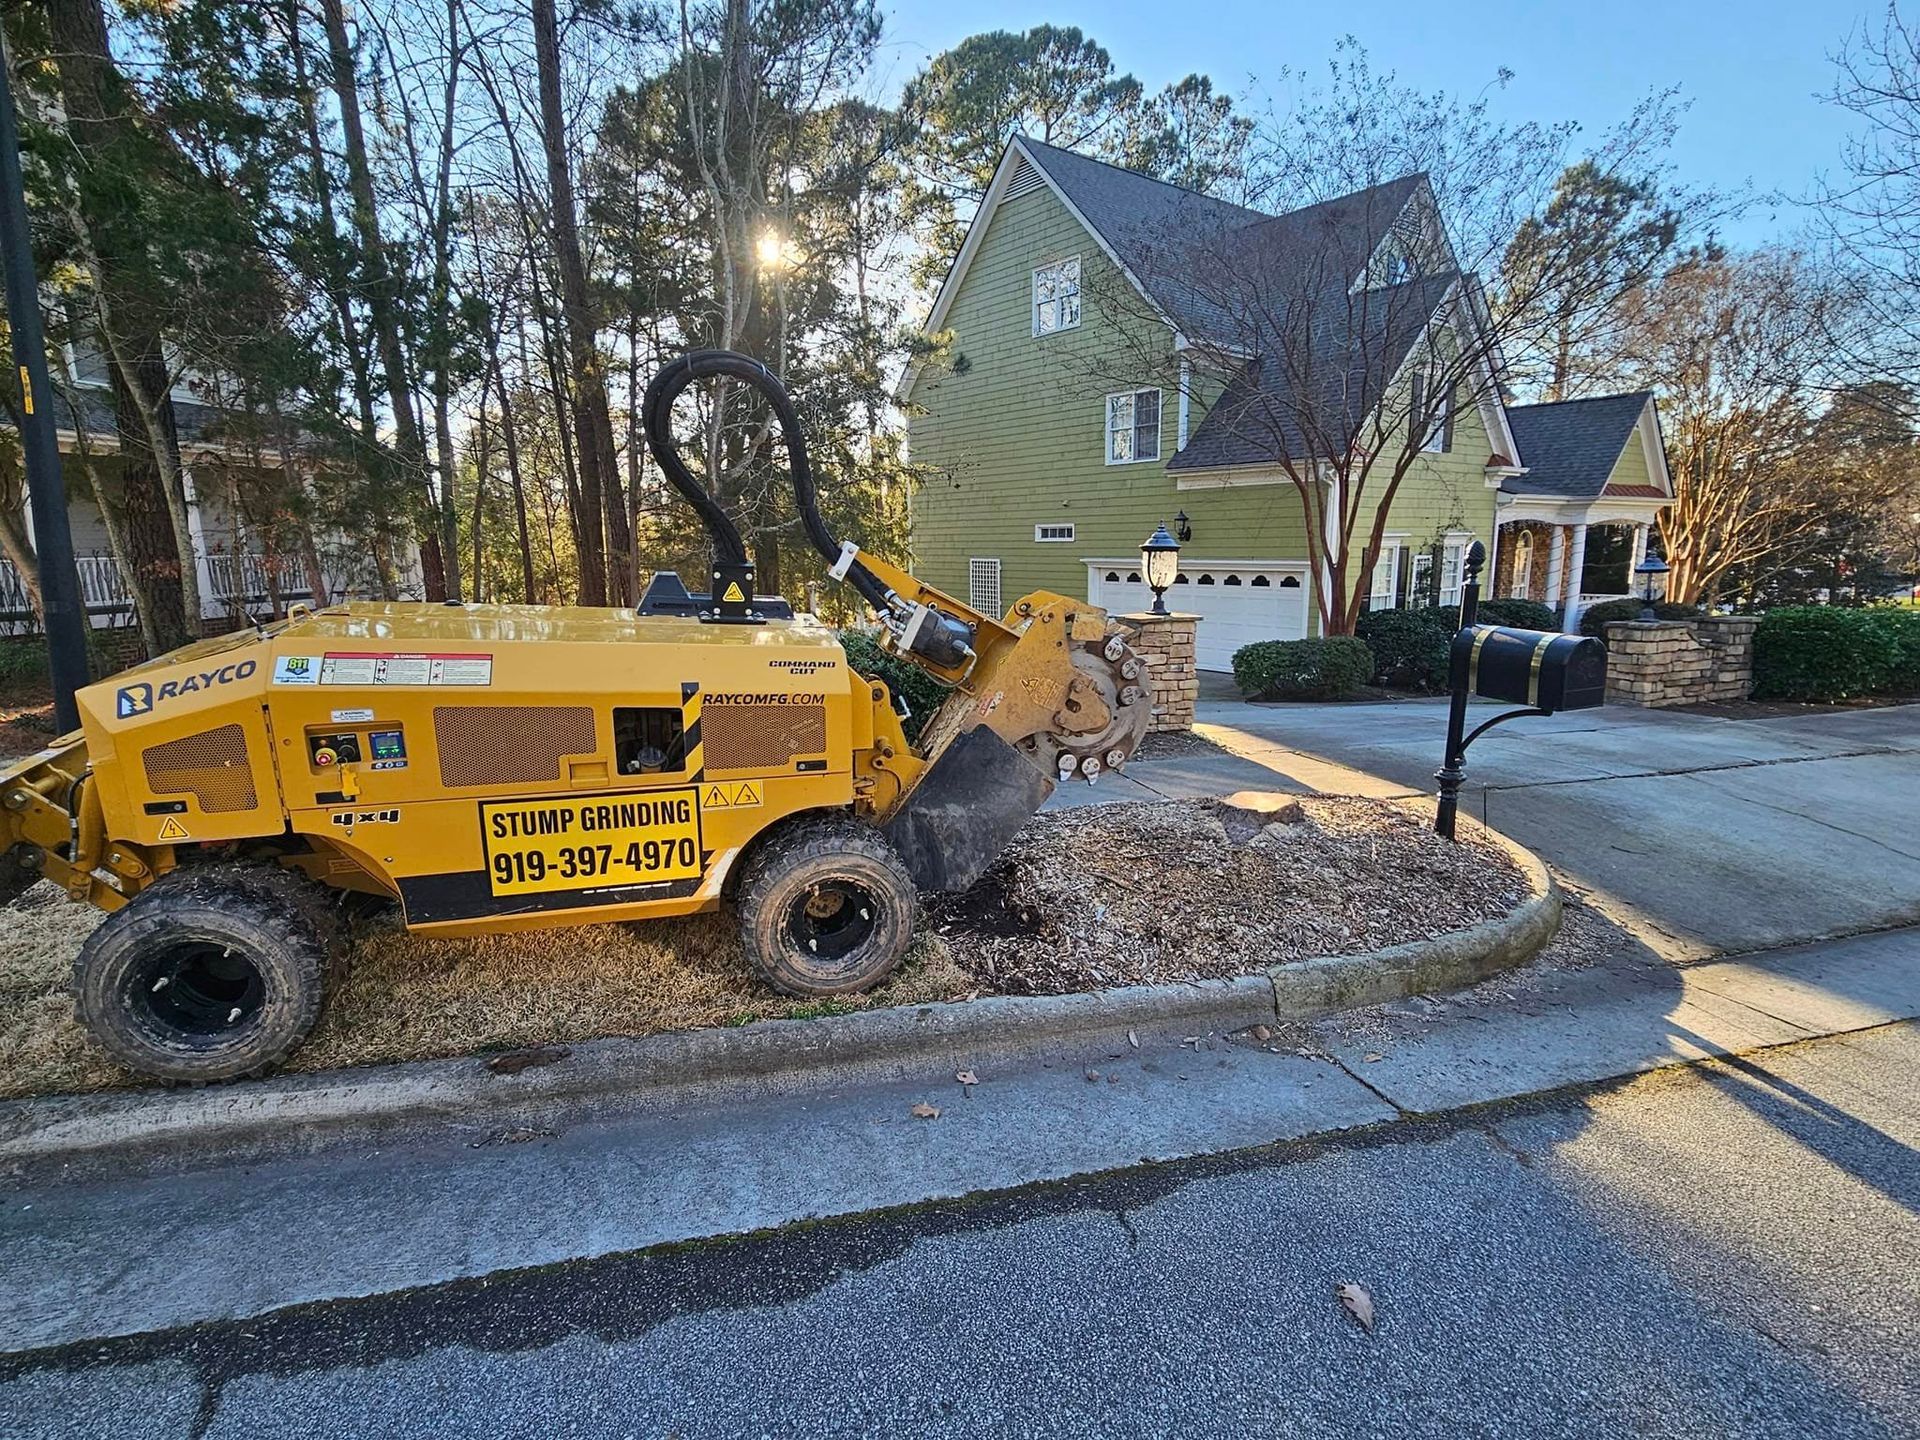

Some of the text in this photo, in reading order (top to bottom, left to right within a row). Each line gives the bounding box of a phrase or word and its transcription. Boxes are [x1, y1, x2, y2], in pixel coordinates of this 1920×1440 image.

[158, 660, 257, 701] RAYCO
[288, 657, 309, 670] 811
[702, 693, 825, 705] RAYCOMFG.COM
[492, 799, 691, 838] STUMP GRINDING
[493, 837, 696, 884] 919-397-4970
